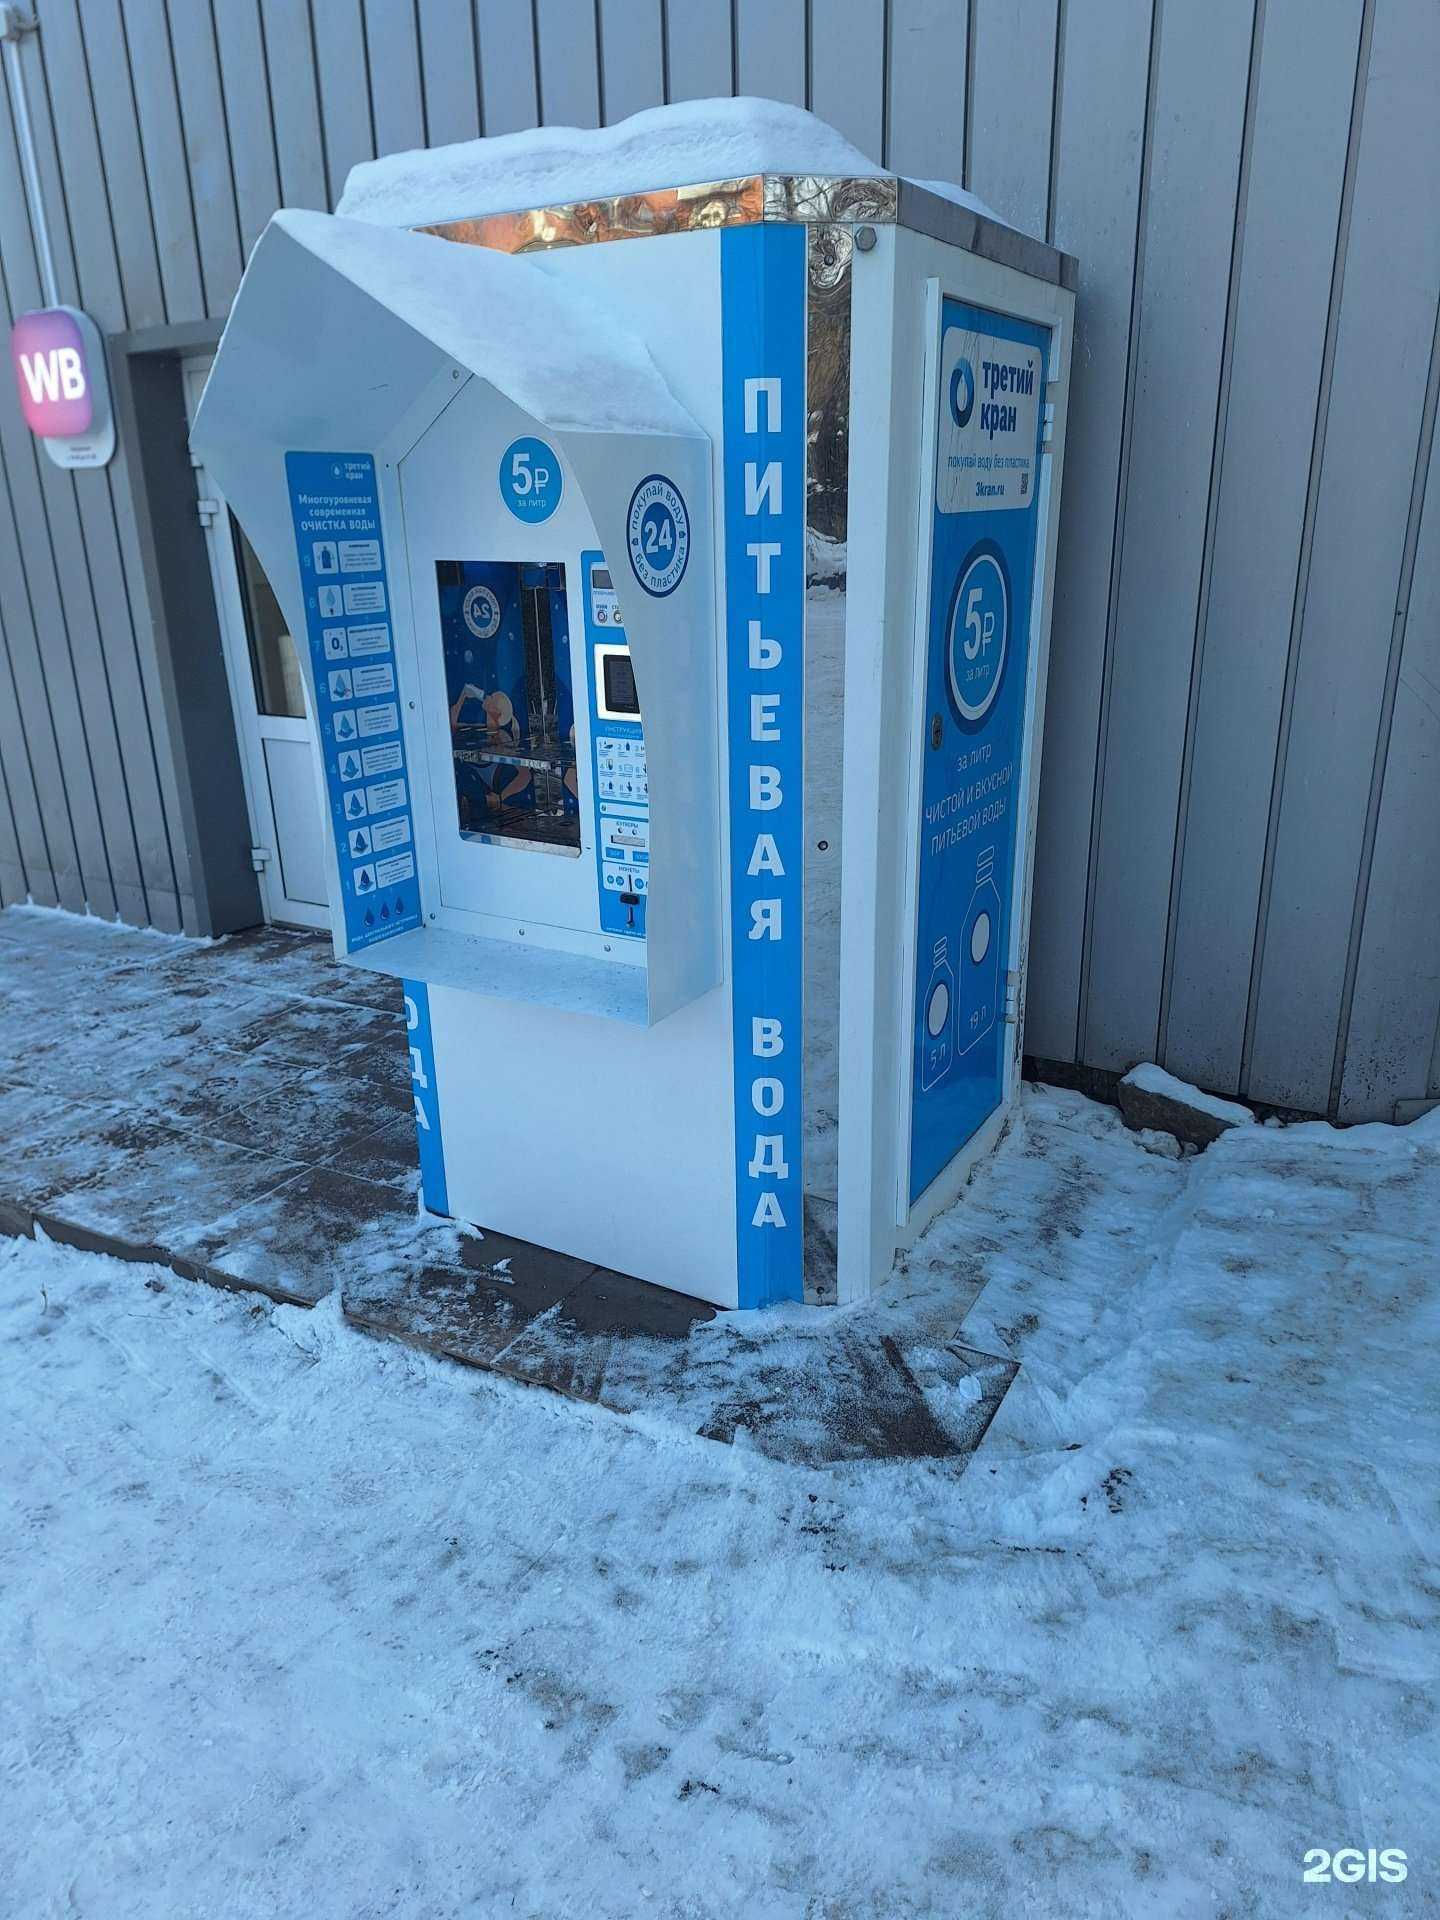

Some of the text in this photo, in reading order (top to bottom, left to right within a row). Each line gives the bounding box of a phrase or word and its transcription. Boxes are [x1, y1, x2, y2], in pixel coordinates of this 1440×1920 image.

[19, 347, 86, 404] WB
[982, 360, 1034, 399] третий
[980, 403, 1017, 440] кран
[977, 455, 993, 472] воду
[976, 481, 1005, 497] 3kran.ru
[632, 481, 685, 531] покупай воду
[301, 519, 376, 532] ОЧИСТКА ВОДЫ
[644, 518, 673, 554] 24
[635, 553, 649, 580] без
[966, 664, 991, 681] за литр
[956, 744, 992, 772] за литр
[743, 377, 789, 1228] ПИТЬЕВАЯ ВОДА
[925, 761, 1013, 824] ЧИСТОЙ И ВКУСНОЙ
[931, 797, 1007, 857] ПИТЬЕВОЙ ВОДЫ
[970, 1010, 979, 1030] 19
[930, 1048, 938, 1071] 5
